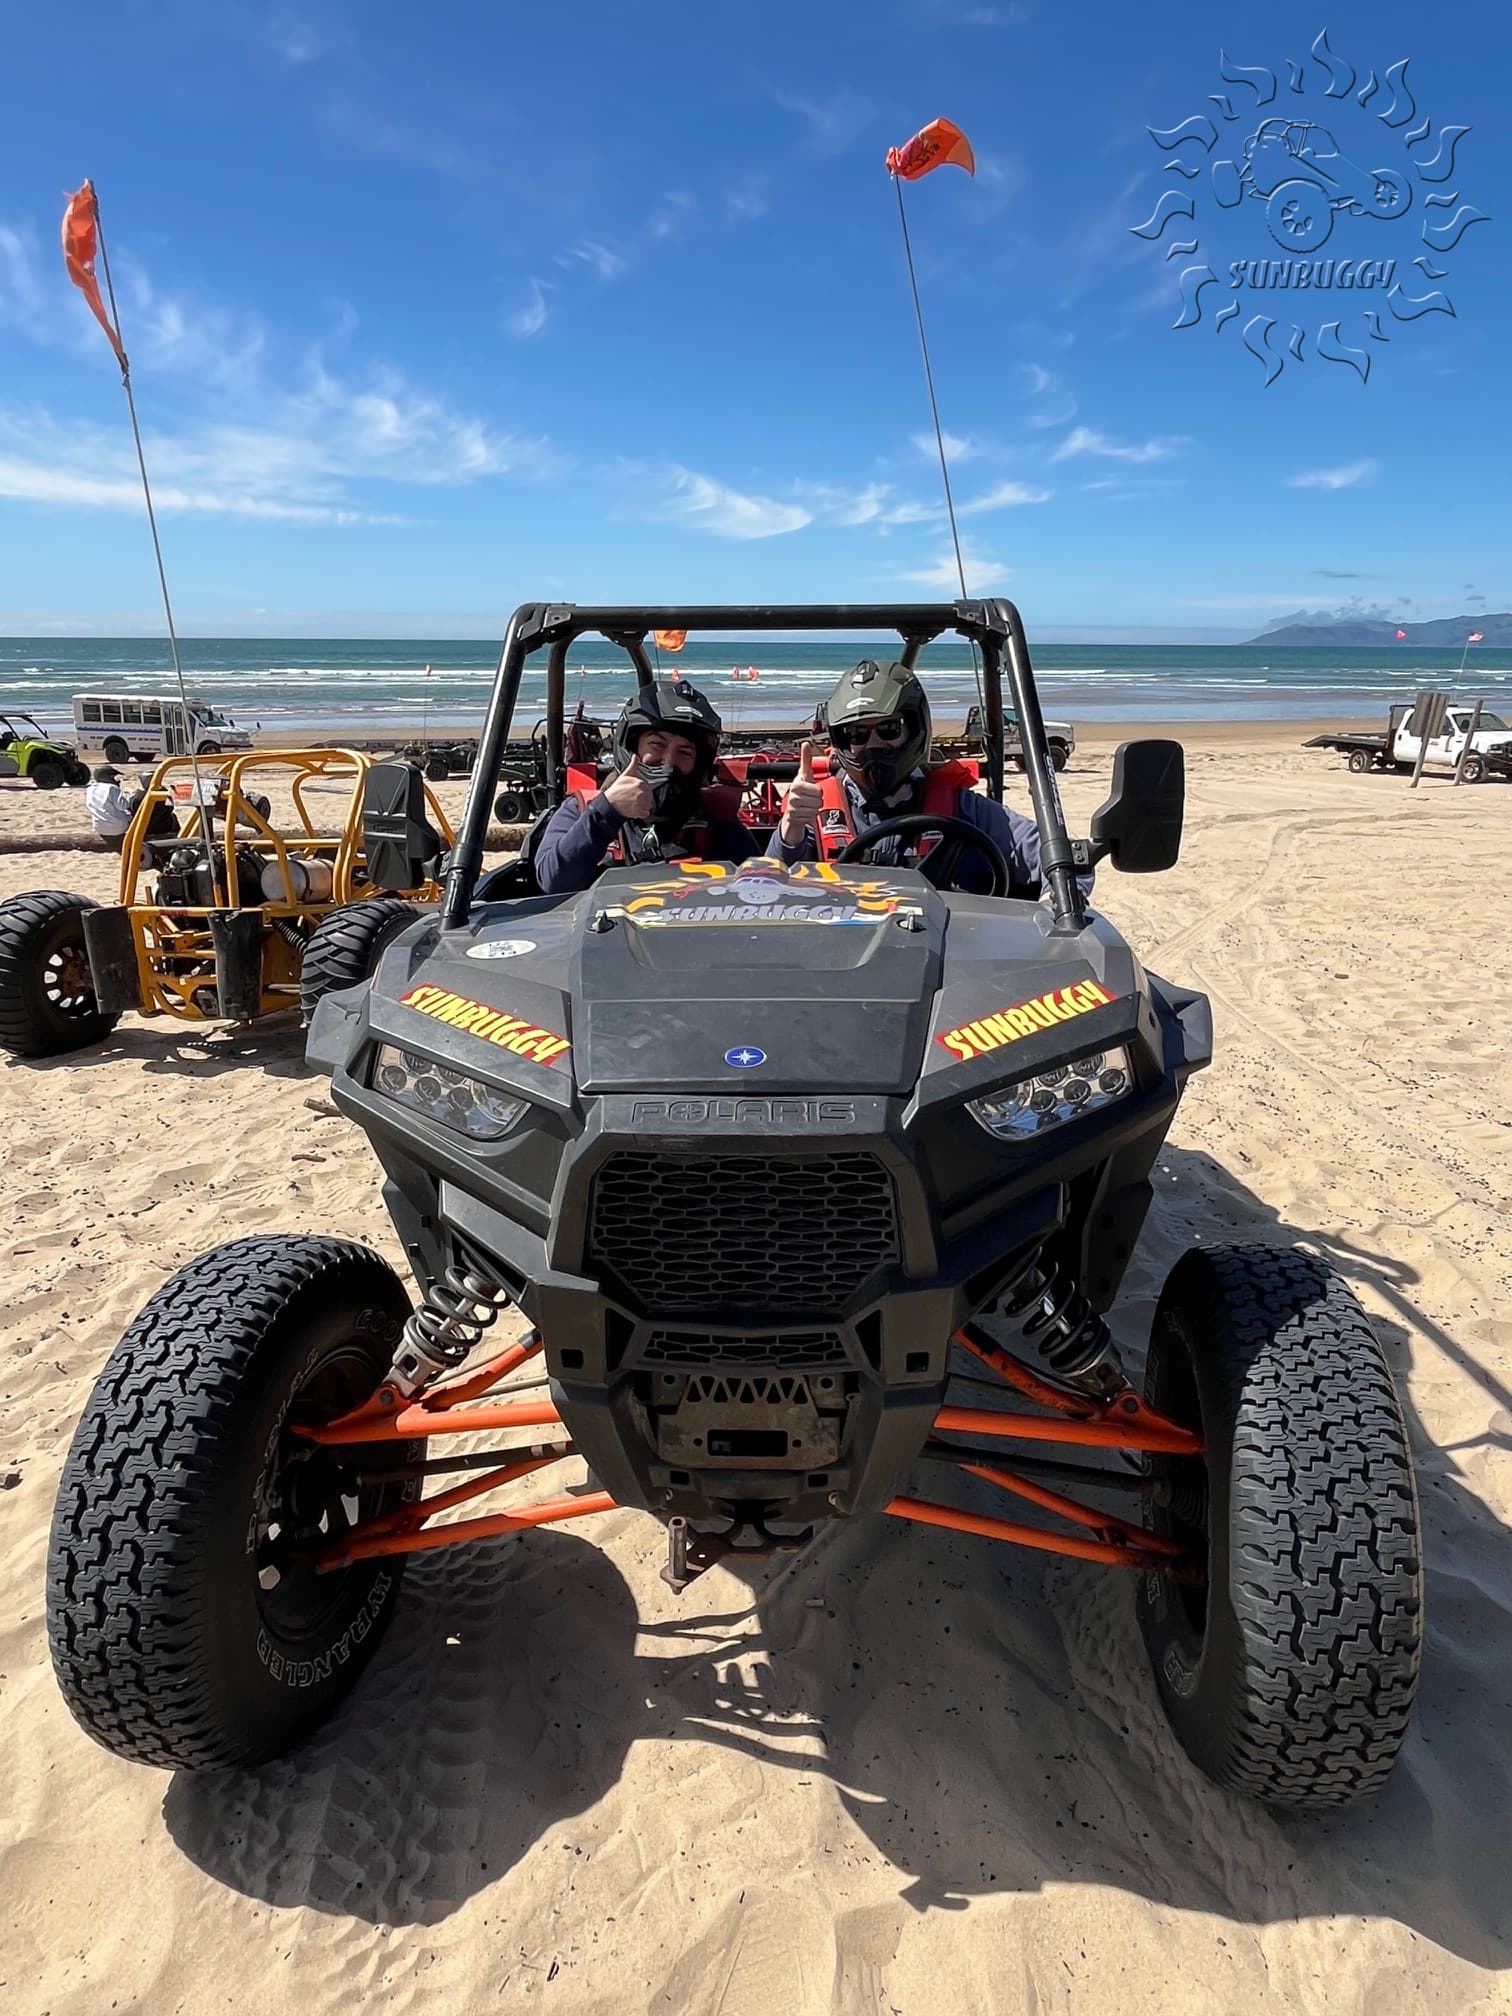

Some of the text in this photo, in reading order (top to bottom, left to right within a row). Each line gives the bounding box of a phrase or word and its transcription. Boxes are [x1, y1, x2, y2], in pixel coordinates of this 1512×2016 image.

[660, 904, 858, 921] SUNBUGGY
[400, 986, 571, 1063] SUNBUGGY
[943, 979, 1110, 1060] SUNBUGGY
[632, 1100, 856, 1124] POLARIS
[256, 1571, 392, 1687] WRANGLER
